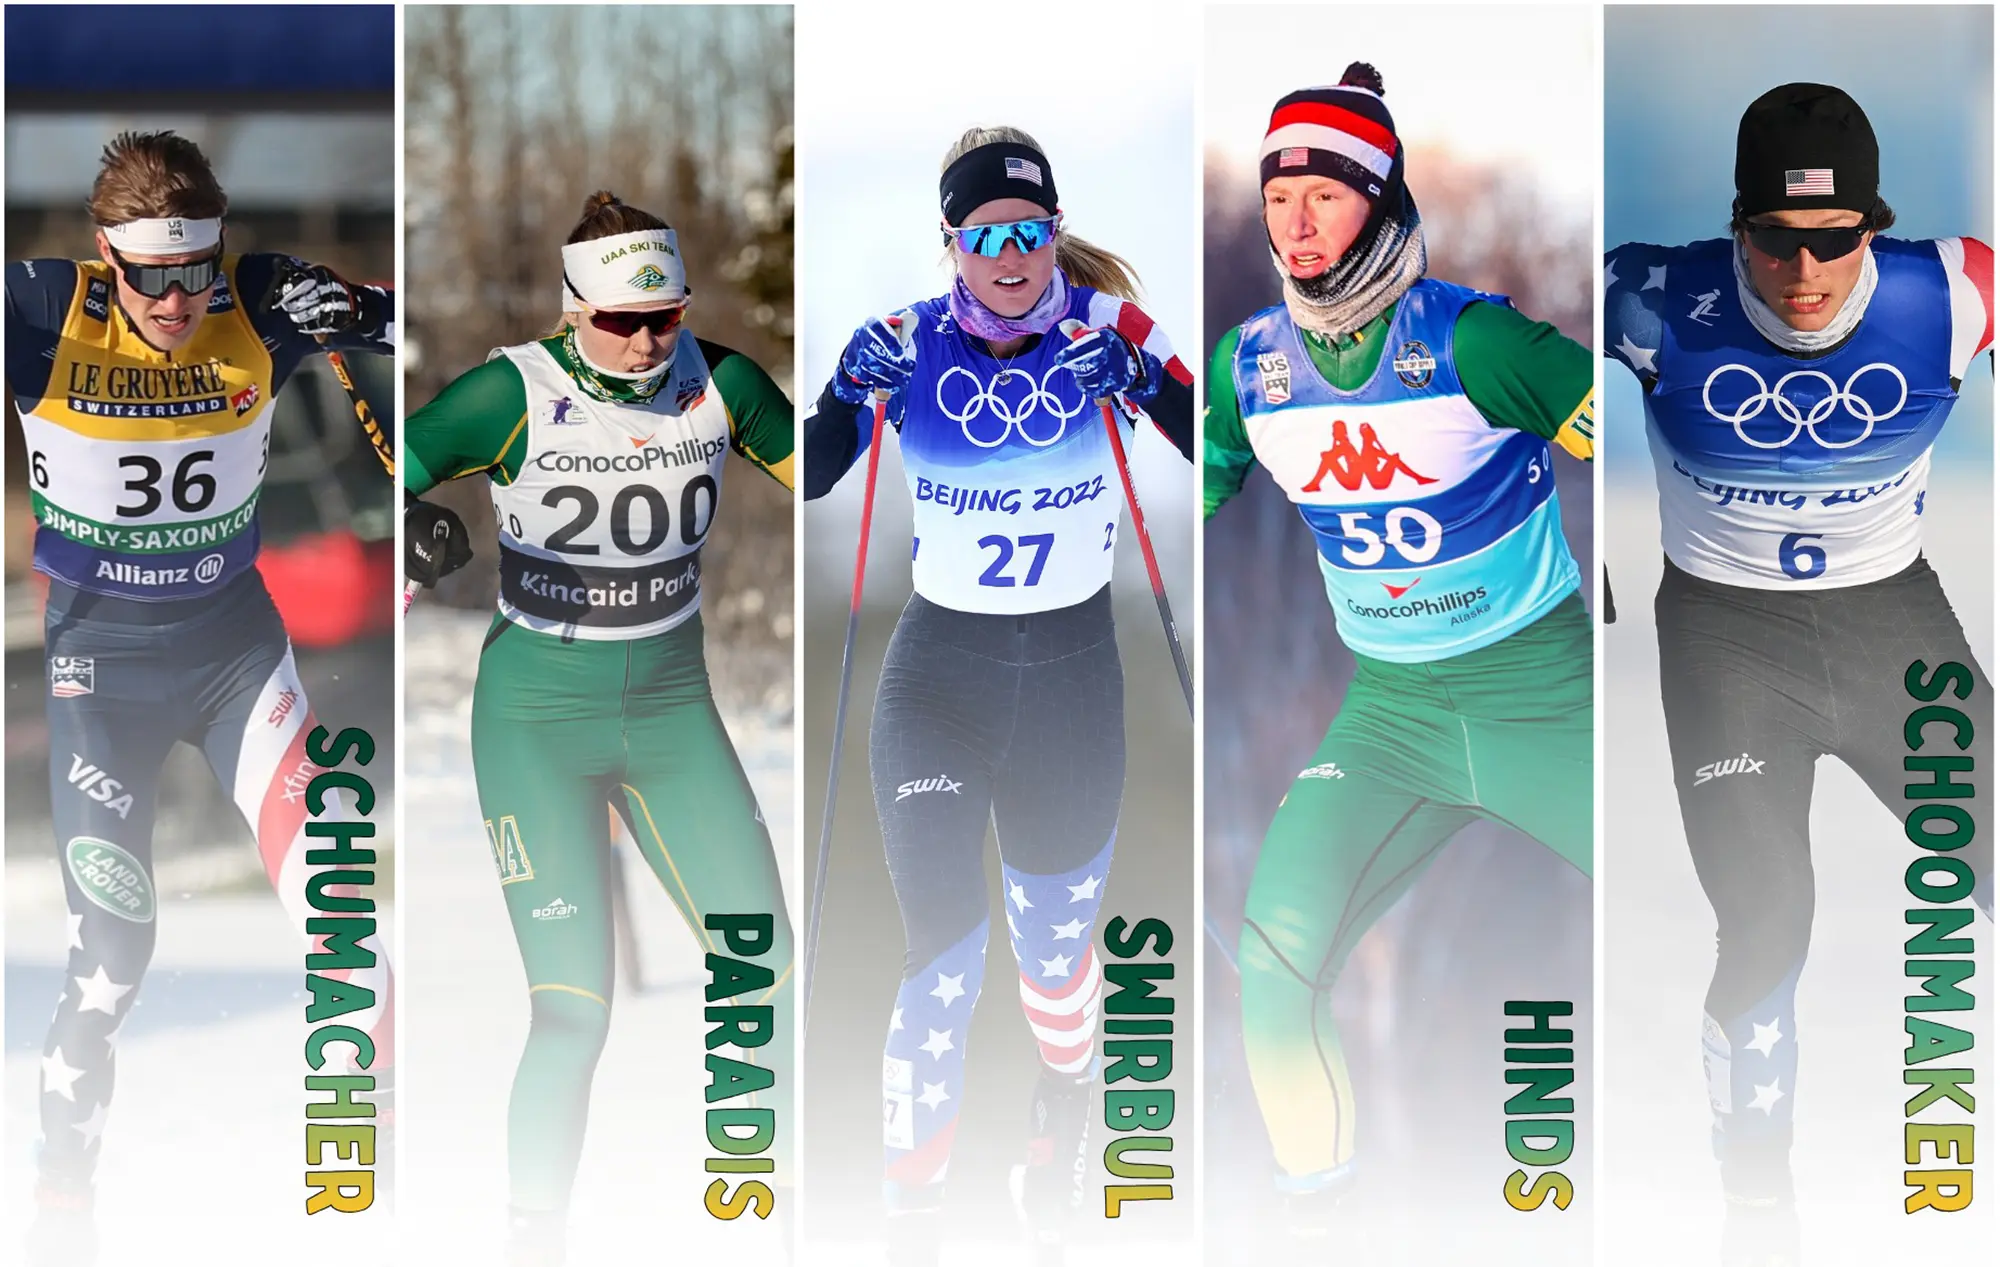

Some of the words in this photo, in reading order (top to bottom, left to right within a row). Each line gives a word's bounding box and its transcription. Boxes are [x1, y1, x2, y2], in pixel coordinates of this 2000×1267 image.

[601, 248, 627, 265] UAA
[629, 242, 650, 253] SKI
[652, 241, 675, 257] TEAM
[68, 361, 101, 397] LE
[679, 376, 701, 388] US
[1259, 358, 1287, 373] US
[72, 399, 221, 417] SWITZERLAND
[535, 435, 726, 472] ConocoPhillips
[115, 450, 217, 518] 36
[916, 476, 1022, 516] BEIJING
[1032, 474, 1108, 512] 2022
[541, 474, 718, 556] 200
[1336, 506, 1442, 566] 50
[95, 559, 189, 585] Allianz
[977, 533, 1055, 588] 27
[1778, 532, 1827, 580] 6
[519, 570, 638, 607] Kincaid
[650, 561, 697, 602] Park
[1347, 586, 1487, 619] ConocoPhillips
[1450, 603, 1492, 626] Alaska
[67, 752, 134, 820] VISA
